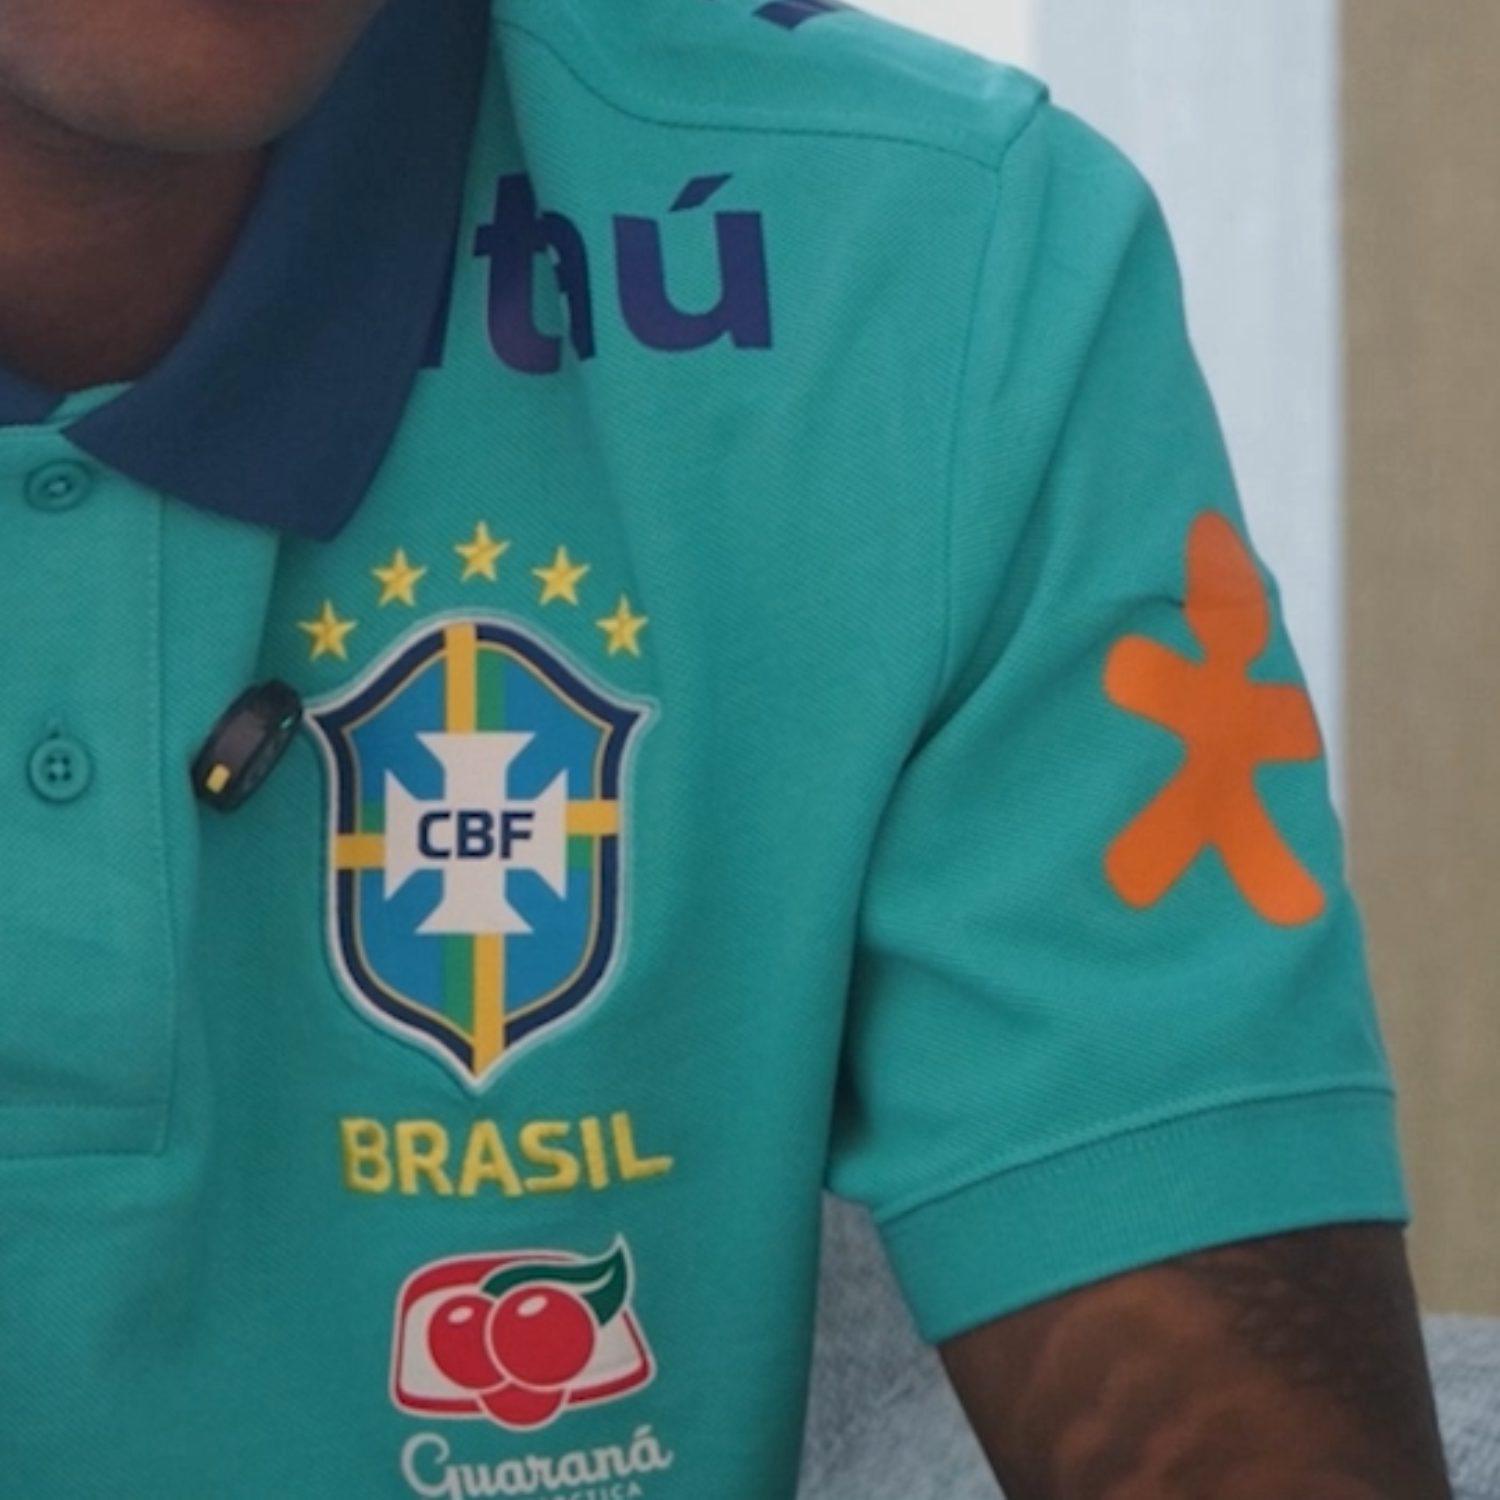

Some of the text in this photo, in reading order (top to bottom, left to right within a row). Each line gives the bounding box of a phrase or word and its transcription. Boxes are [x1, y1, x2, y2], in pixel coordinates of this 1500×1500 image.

[417, 809, 535, 860] CBF
[339, 1111, 675, 1198] BRASIL
[401, 1424, 674, 1500] Guaraná
